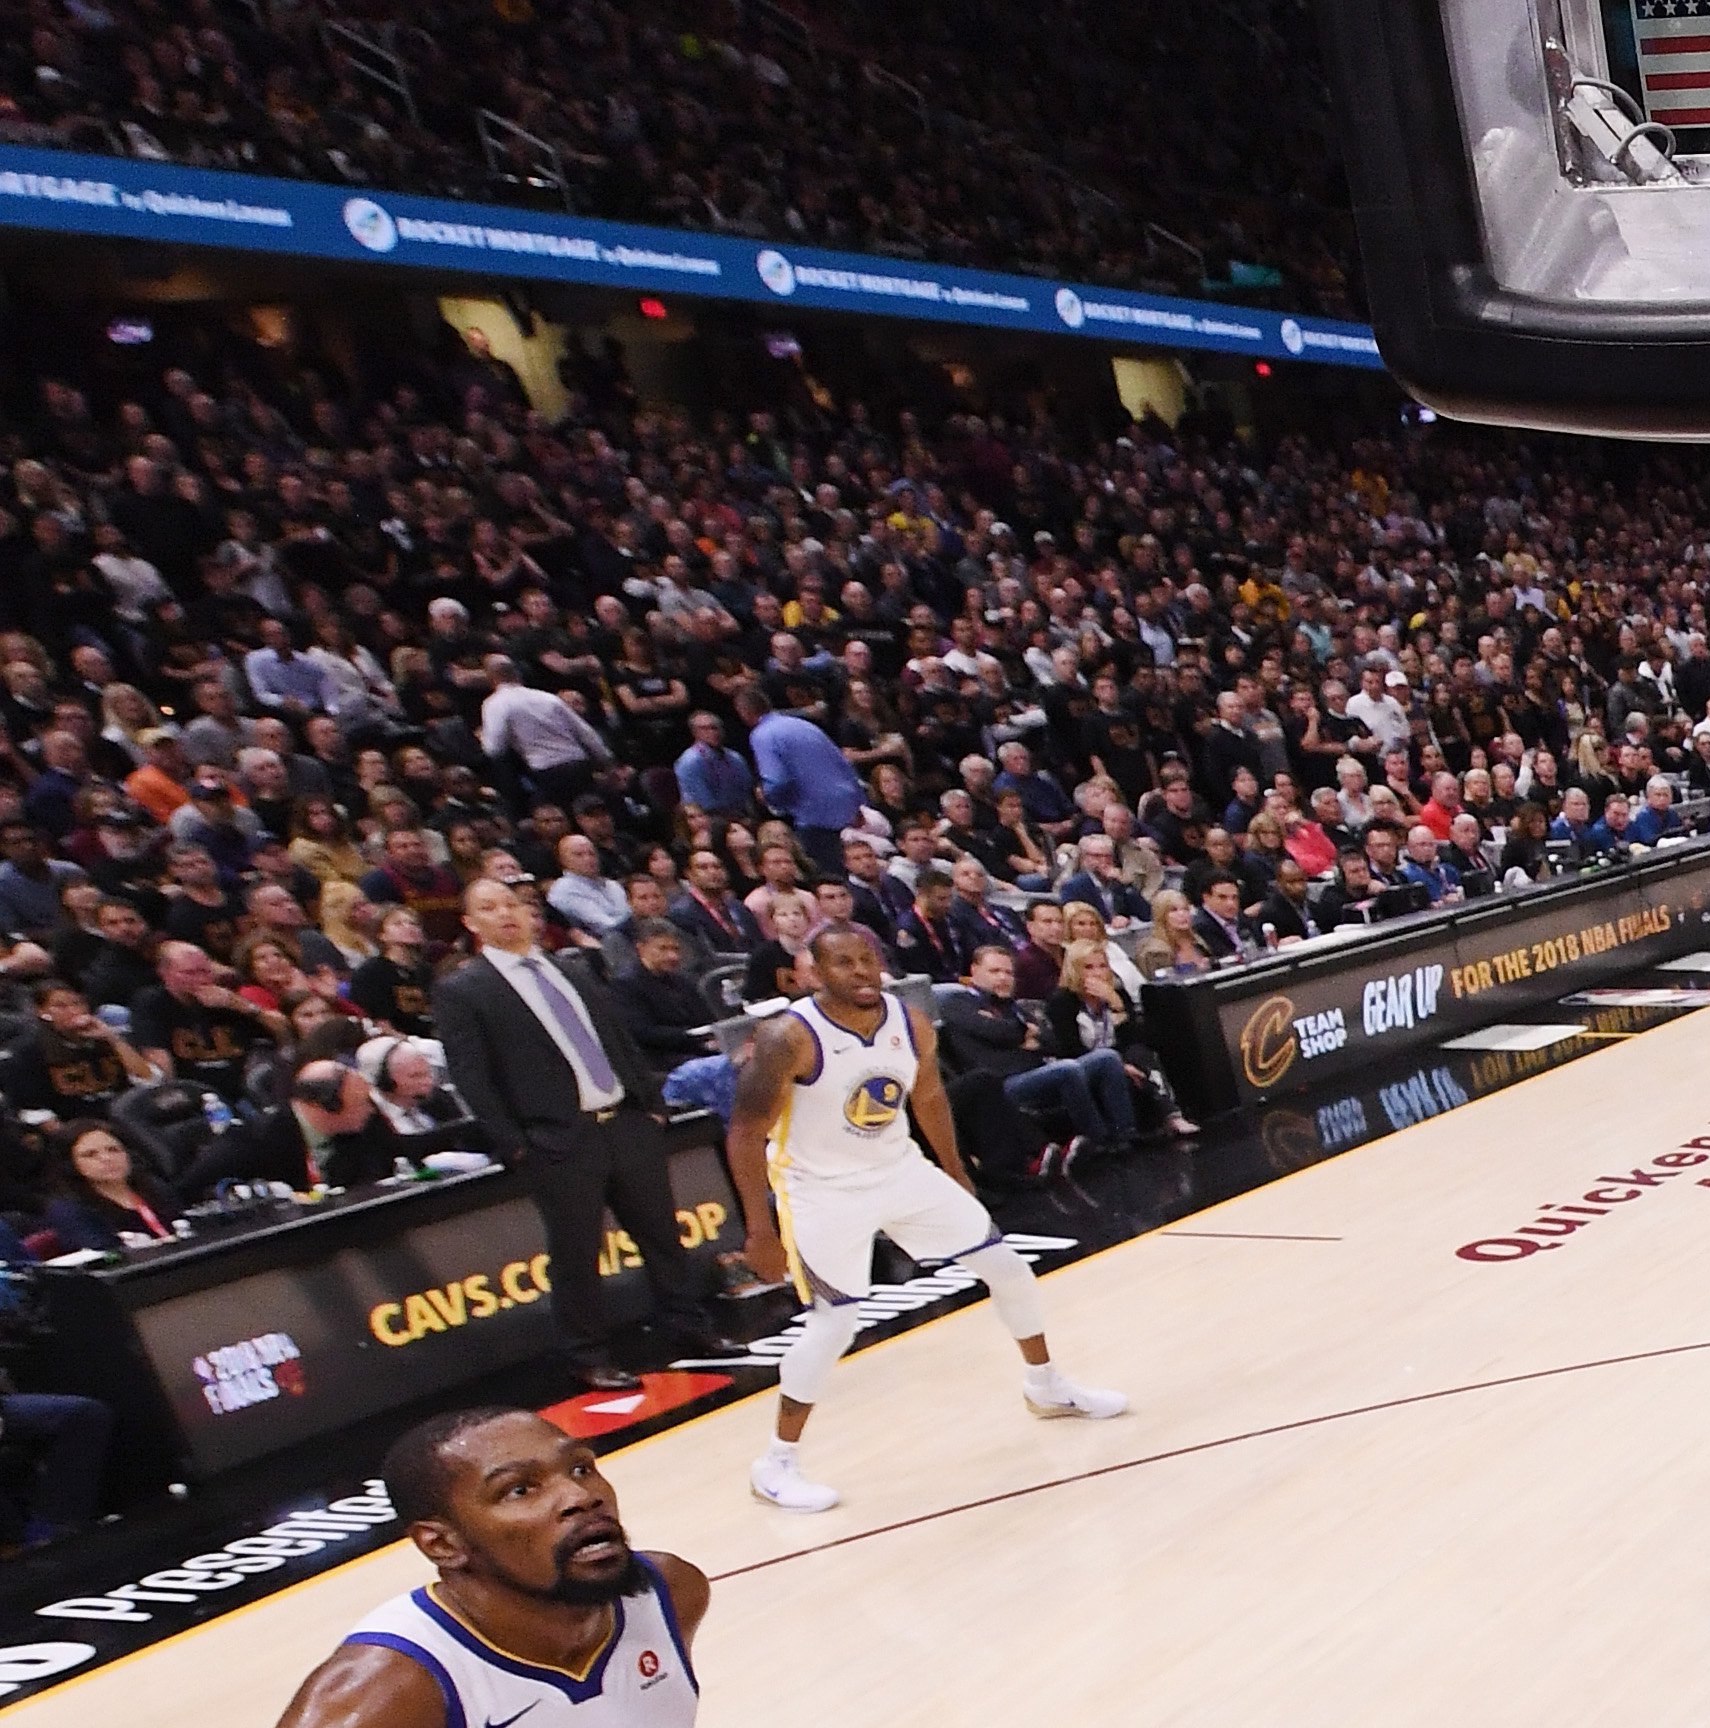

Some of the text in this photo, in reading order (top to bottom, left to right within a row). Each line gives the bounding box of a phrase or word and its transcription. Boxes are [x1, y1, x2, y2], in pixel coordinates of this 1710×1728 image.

[1451, 904, 1672, 999] FOR THE 2018 NBA FINALS
[1362, 963, 1444, 1037] GEAR UP
[1292, 1007, 1345, 1040] TEAM
[1299, 1028, 1348, 1059] SHOP
[883, 1083, 898, 1103] 9
